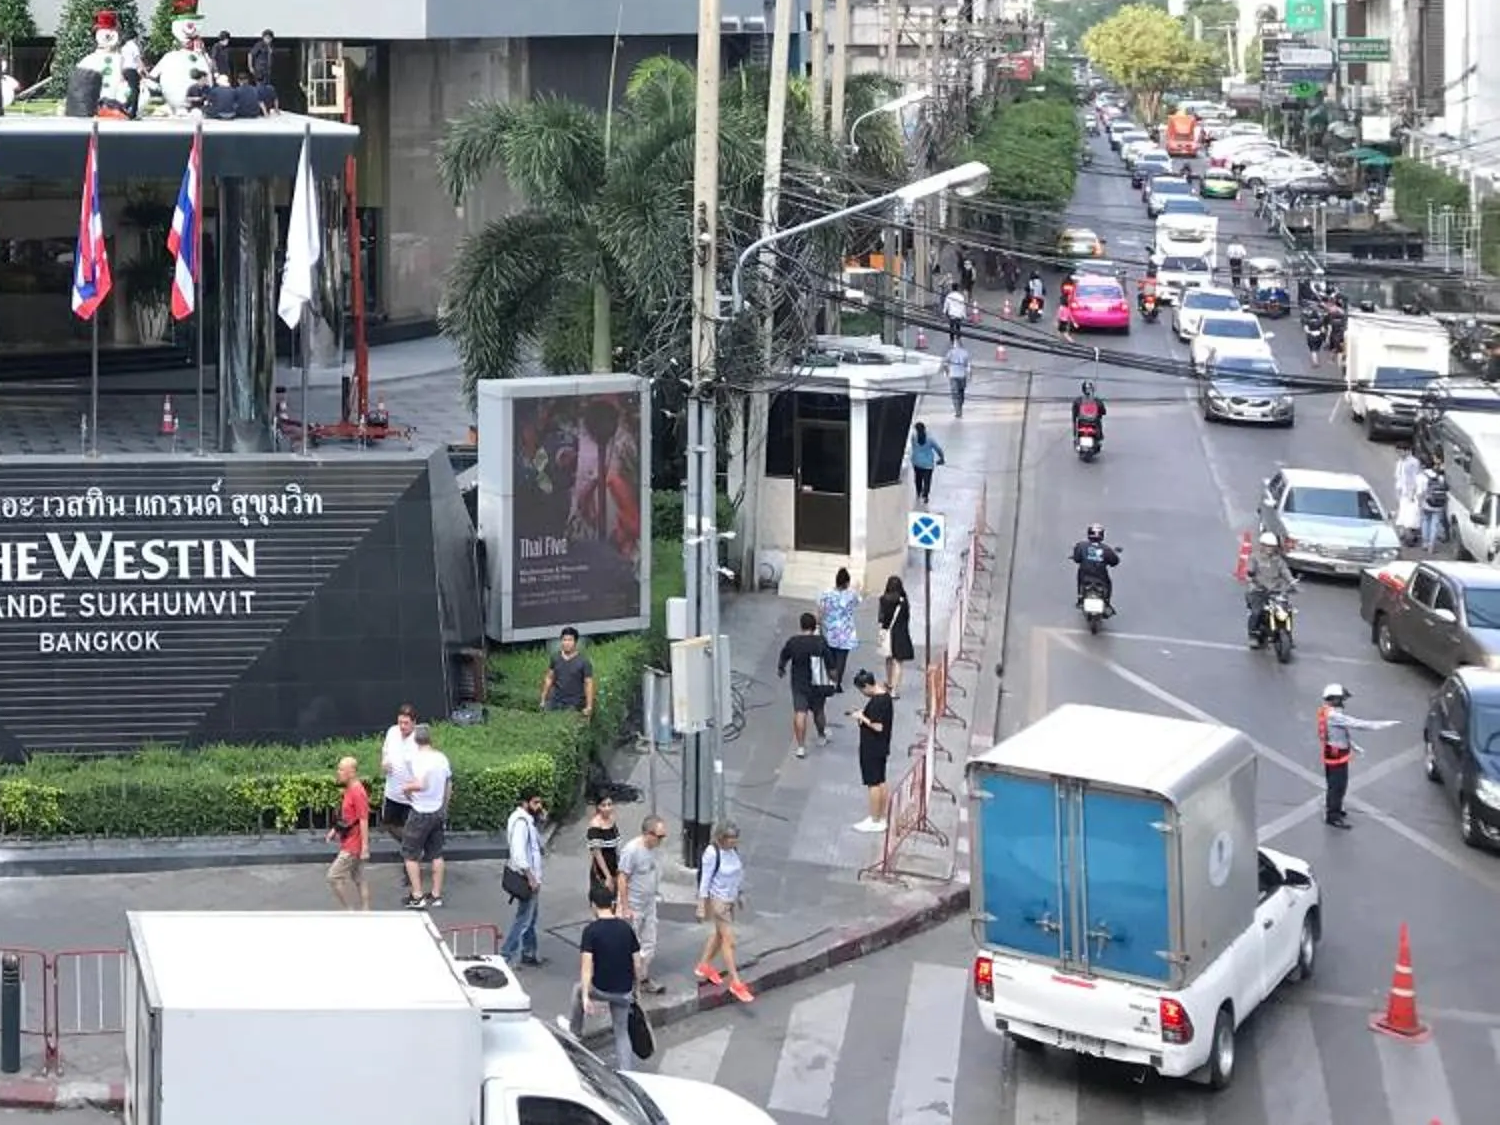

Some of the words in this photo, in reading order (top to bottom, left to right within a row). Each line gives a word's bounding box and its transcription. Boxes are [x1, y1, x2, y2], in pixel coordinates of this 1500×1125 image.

[135, 477, 222, 516] แกรนด์
[231, 483, 323, 526] สุขุมวิท
[45, 530, 257, 580] WESTIN
[79, 590, 257, 618] SUKHUMVIT
[38, 630, 161, 652] BANGKOK
